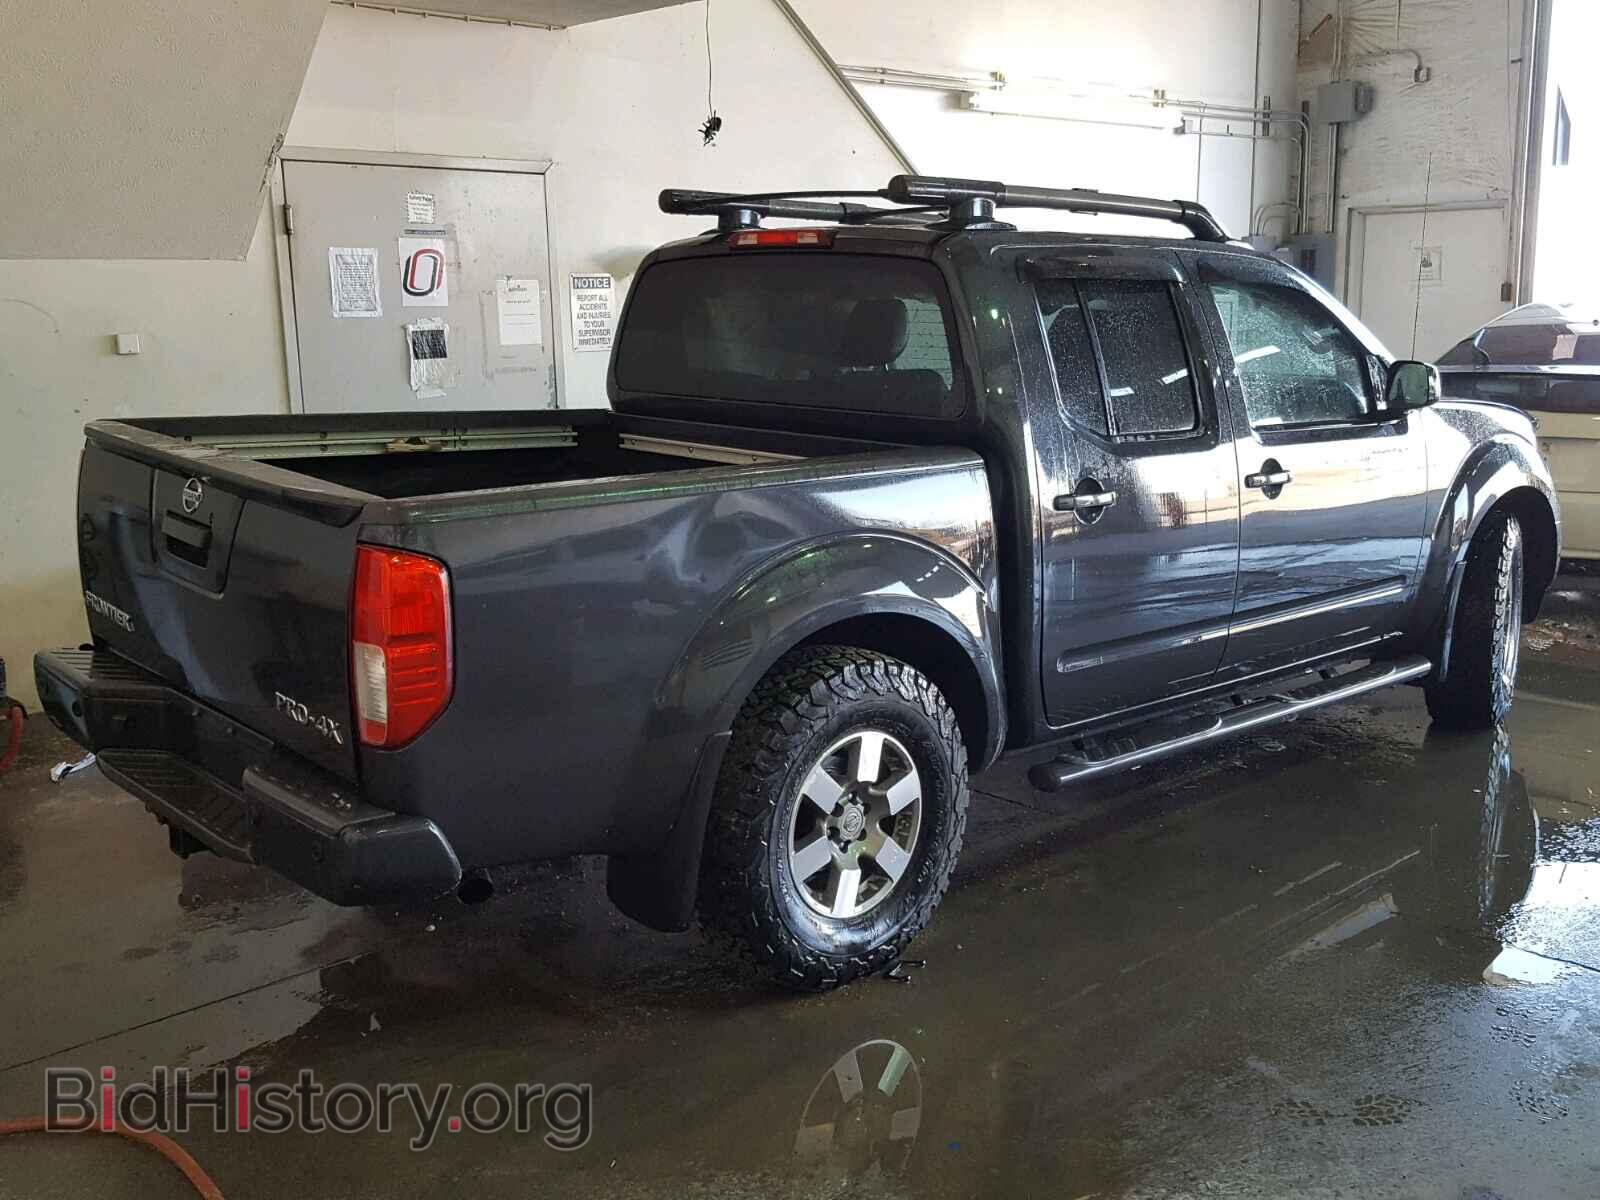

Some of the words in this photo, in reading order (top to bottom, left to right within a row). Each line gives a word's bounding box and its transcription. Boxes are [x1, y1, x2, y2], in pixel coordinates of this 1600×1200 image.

[575, 278, 609, 288] NOTICE
[576, 294, 597, 302] REPORT
[599, 294, 608, 302] ALL
[579, 303, 608, 311] ACCIDENTS
[577, 312, 587, 320] AND
[589, 312, 611, 320] INJURIES
[584, 320, 590, 328] TO
[591, 320, 605, 328] YOUR
[578, 329, 611, 337] SUPERVISOR
[86, 590, 135, 632] FRONTIER
[275, 691, 344, 744] PRO-4X
